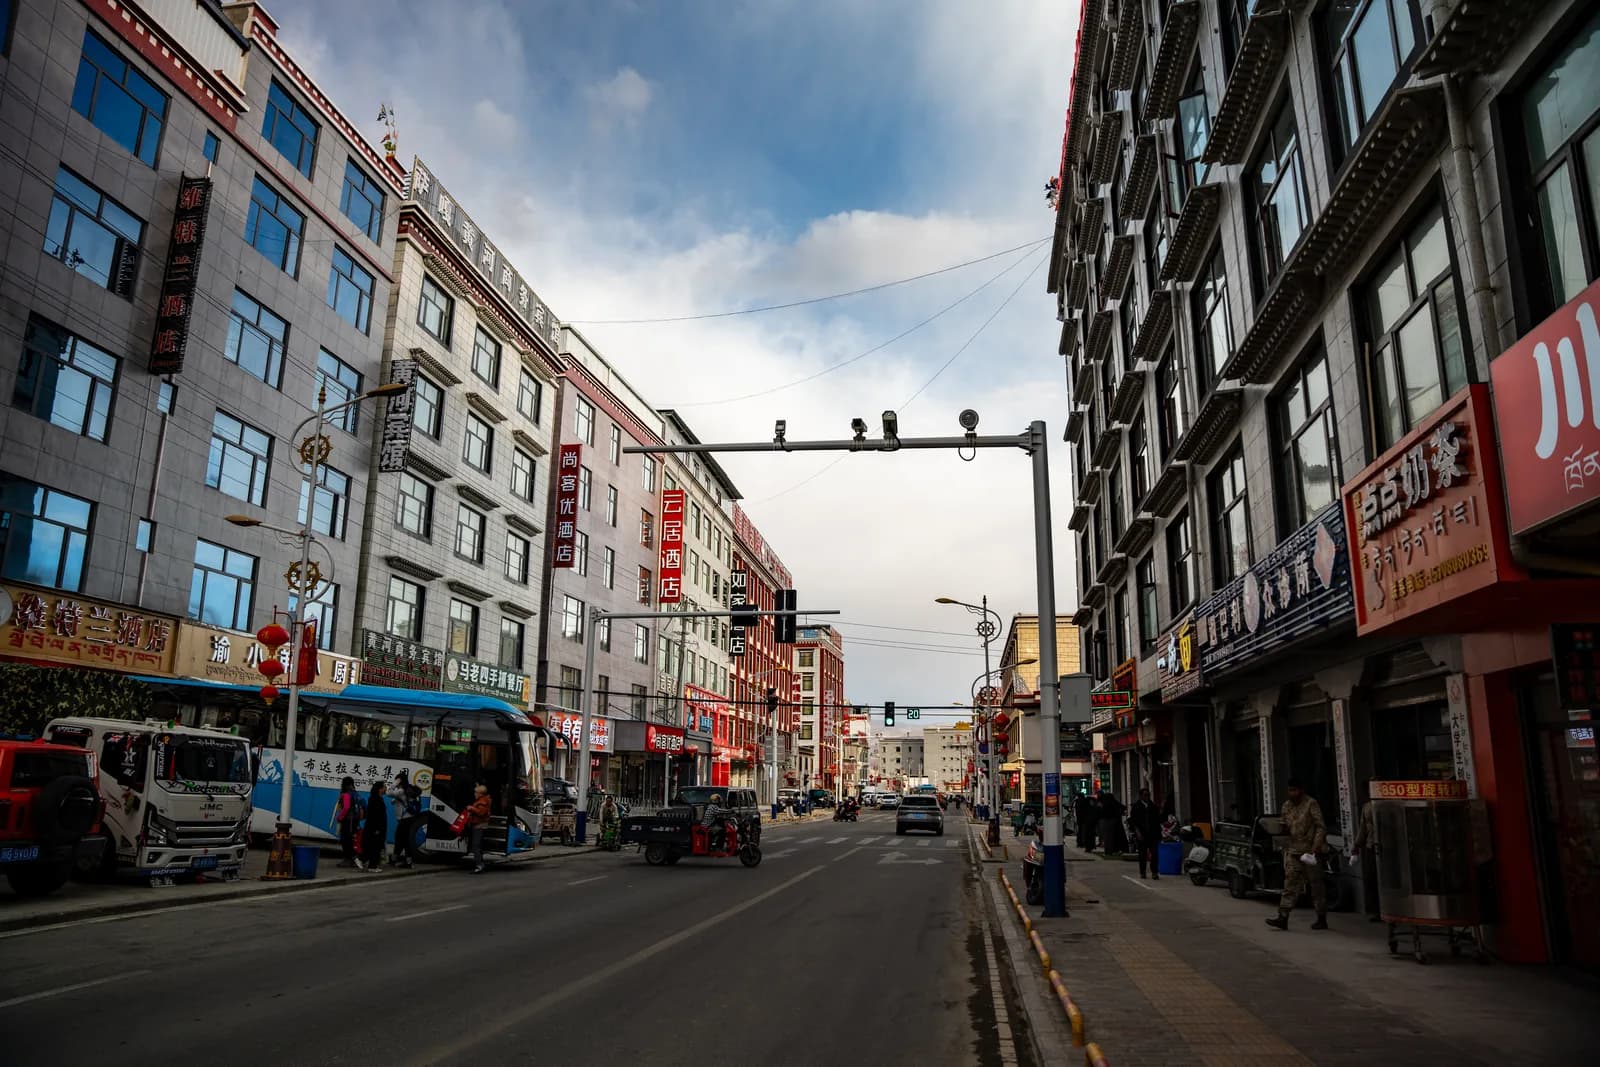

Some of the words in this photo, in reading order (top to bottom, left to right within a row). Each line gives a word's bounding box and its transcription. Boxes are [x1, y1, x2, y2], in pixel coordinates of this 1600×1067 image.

[156, 186, 204, 354] 维特兰酒店
[1533, 302, 1600, 459] 川
[556, 451, 577, 562] 尚客优酒店
[660, 493, 682, 599] 云居酒店
[16, 593, 169, 653] 维特兰酒店
[731, 573, 746, 655] 如家店
[368, 632, 443, 668] 黄河商务宾馆
[460, 660, 523, 692] 马老四手抓餐厅
[908, 709, 919, 719] 20
[200, 803, 223, 811] JMC
